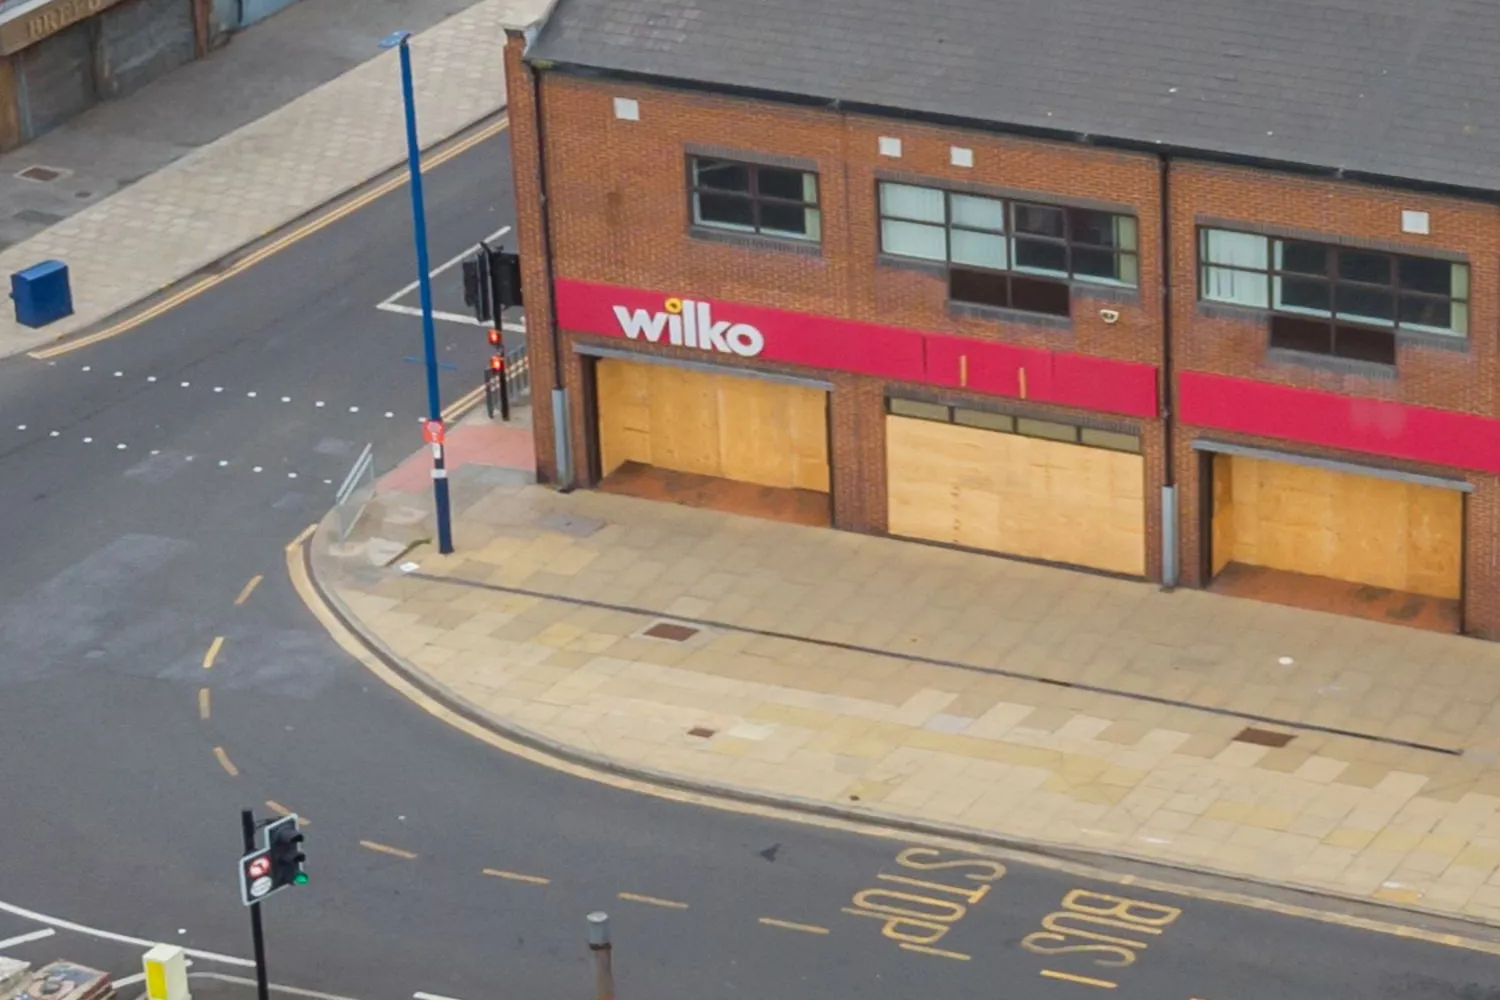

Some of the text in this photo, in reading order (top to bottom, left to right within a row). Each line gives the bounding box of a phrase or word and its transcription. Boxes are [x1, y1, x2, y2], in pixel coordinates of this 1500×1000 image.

[612, 298, 765, 357] wilko
[840, 847, 1006, 945] STOP
[1021, 888, 1183, 967] BUS
